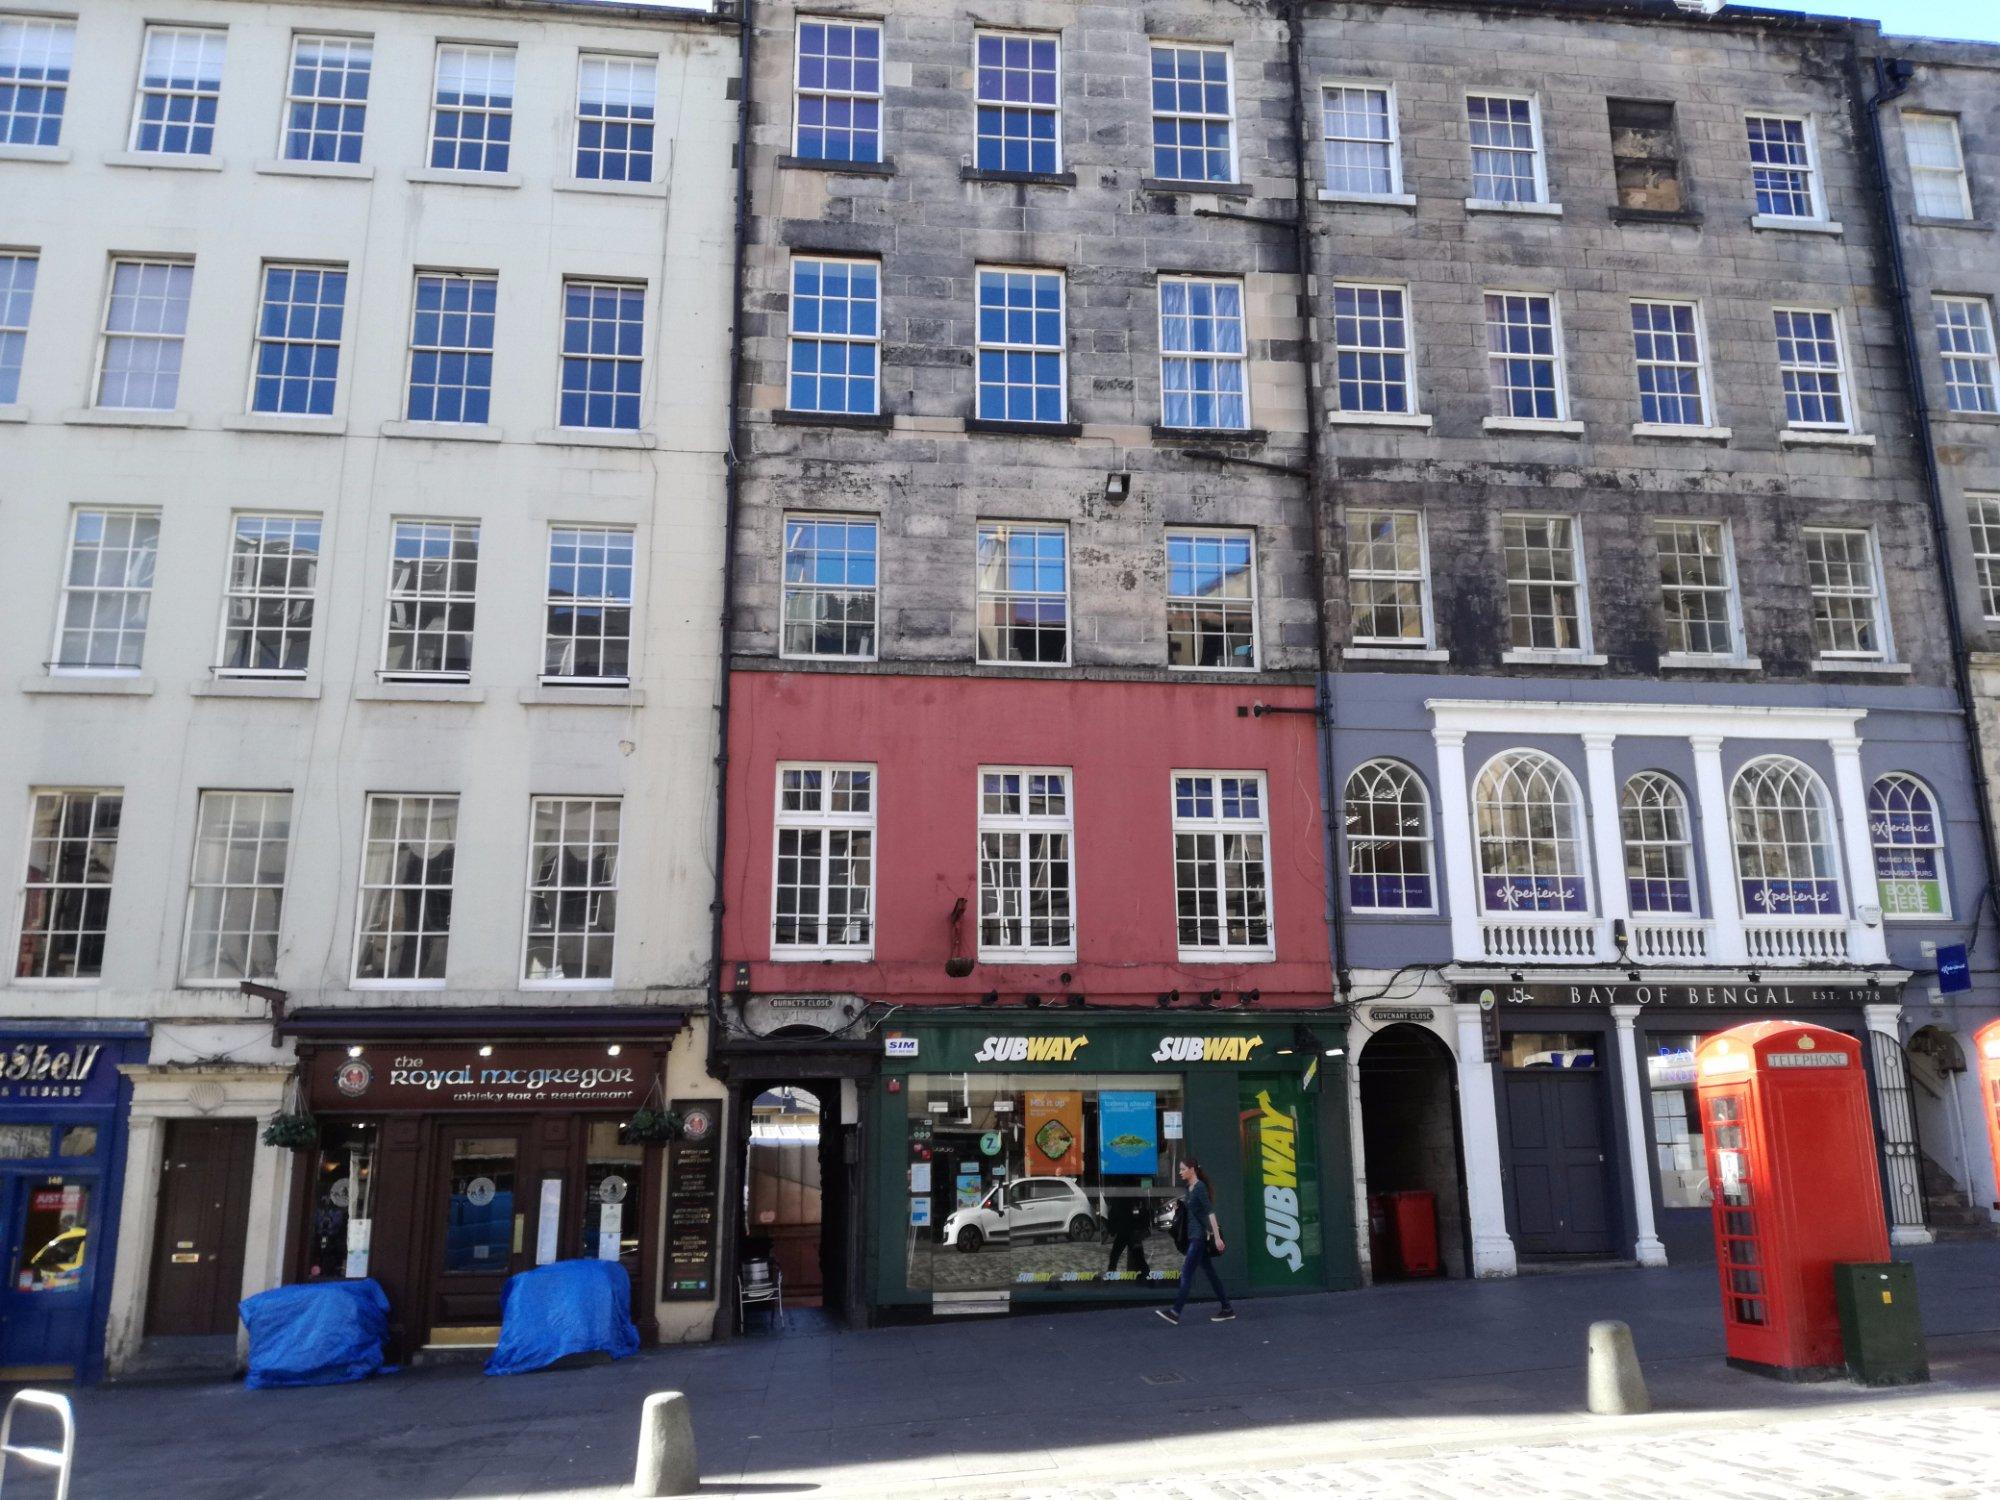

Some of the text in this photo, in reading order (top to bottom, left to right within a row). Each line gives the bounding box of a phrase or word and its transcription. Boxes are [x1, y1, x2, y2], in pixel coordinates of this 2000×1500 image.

[1886, 885, 1927, 896] BOOK
[1888, 897, 1929, 909] HERE
[1570, 987, 1881, 1004] BAY OF BENGAL EST. 1978
[888, 1041, 915, 1049] SIM
[974, 1034, 1089, 1063] SUBWAY
[1151, 1034, 1264, 1063] SUBWAY
[394, 1056, 423, 1068] the
[1771, 1055, 1845, 1067] TELEPHONE
[1256, 1089, 1304, 1273] SUBWAY
[1016, 1272, 1055, 1283] SUBWAY
[1059, 1271, 1098, 1281] SUBWAY
[1103, 1271, 1142, 1281] SUBWAY
